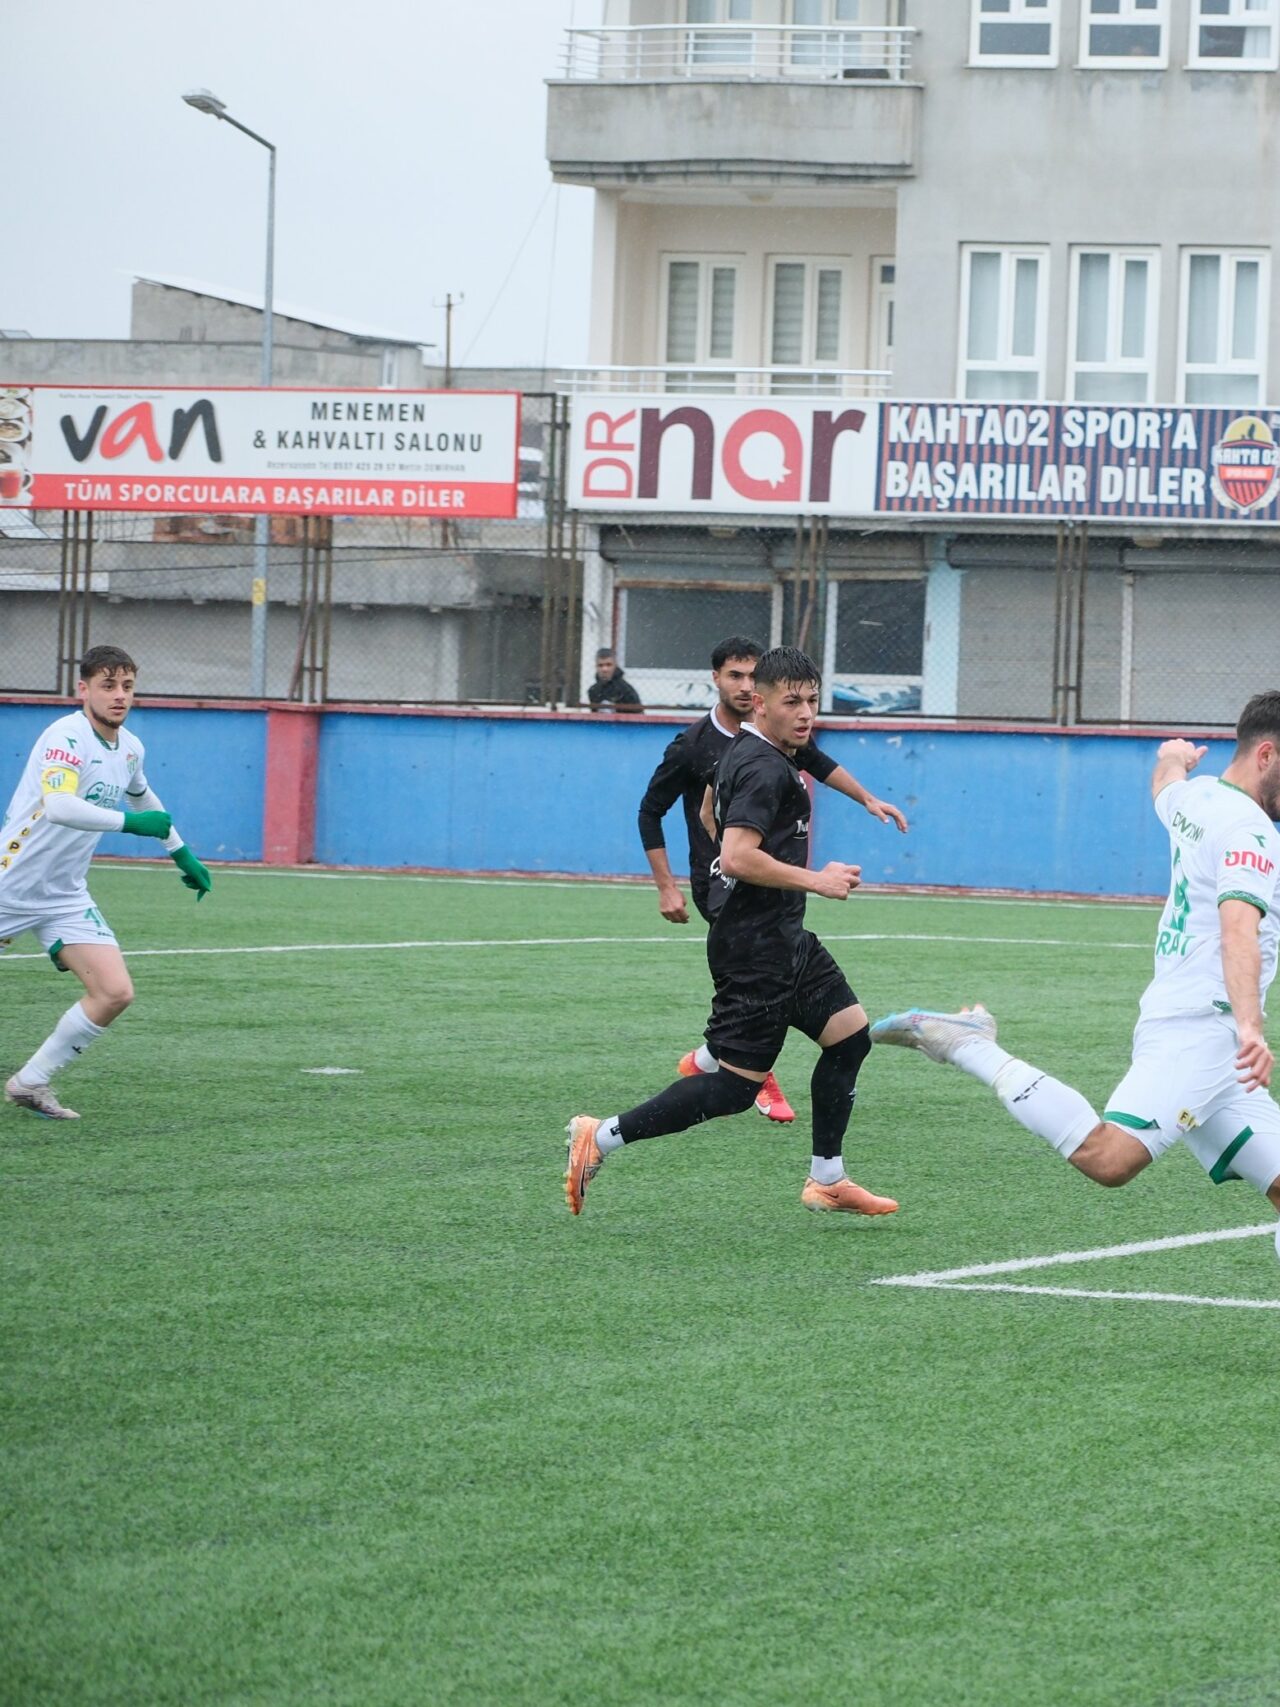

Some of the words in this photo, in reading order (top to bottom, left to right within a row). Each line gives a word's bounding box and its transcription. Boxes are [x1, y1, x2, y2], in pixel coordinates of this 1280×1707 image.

[60, 398, 223, 463] van
[311, 401, 426, 423] MENEMEN
[888, 405, 1050, 447] KAHTA02
[1061, 409, 1199, 450] SPOR'A
[253, 431, 267, 450] &
[276, 431, 385, 452] KAHVALTI
[394, 432, 484, 453] SALONU
[582, 409, 637, 498] DR
[637, 405, 867, 503] nar
[64, 479, 115, 501] TÜM
[119, 483, 266, 504] SPORCULARA
[273, 486, 394, 509] BAŞARILAR
[402, 484, 466, 509] DİLER
[885, 460, 1088, 509] BAŞARILAR
[1100, 457, 1206, 505] DİLER
